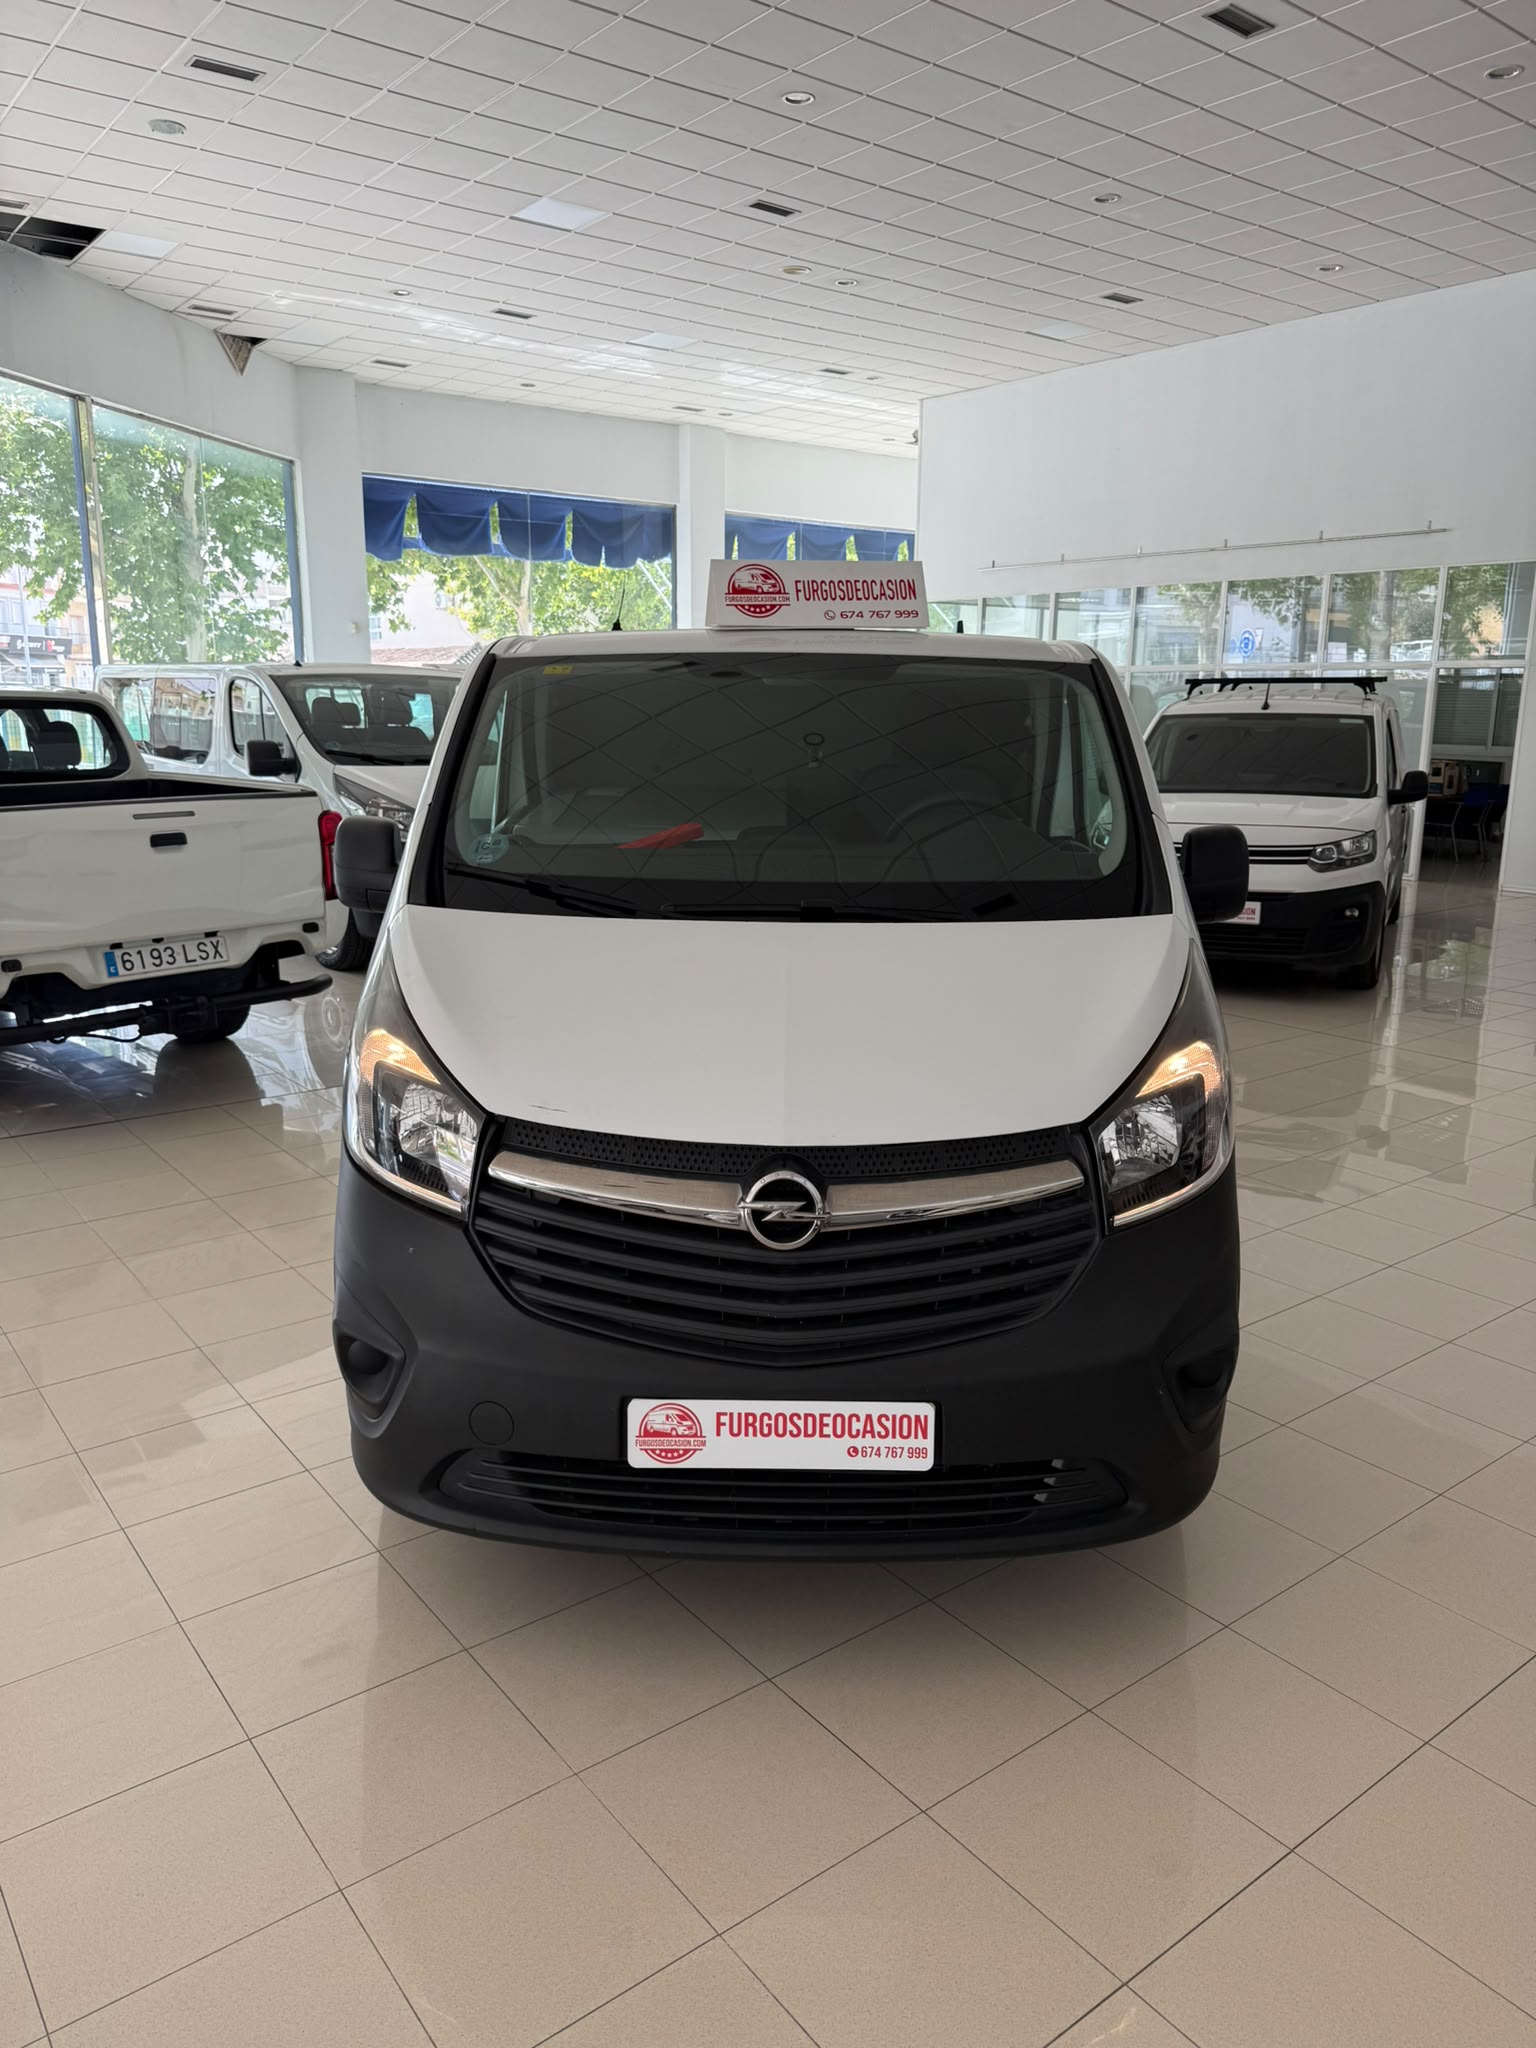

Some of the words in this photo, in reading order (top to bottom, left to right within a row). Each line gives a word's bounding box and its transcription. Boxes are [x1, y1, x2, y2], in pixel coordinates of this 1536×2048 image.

[794, 578, 917, 602] FURGOSDEOCASION
[840, 610, 864, 619] 674
[868, 610, 891, 619] 767
[894, 609, 919, 619] 999
[120, 946, 177, 972] 6193
[182, 939, 224, 964] LSX
[715, 1412, 929, 1439] FURGOSDEOCASION
[635, 1439, 707, 1448] FURGOSDEOCASION.COM
[860, 1446, 882, 1458] 674
[884, 1446, 905, 1459] 767
[907, 1447, 929, 1460] 999
